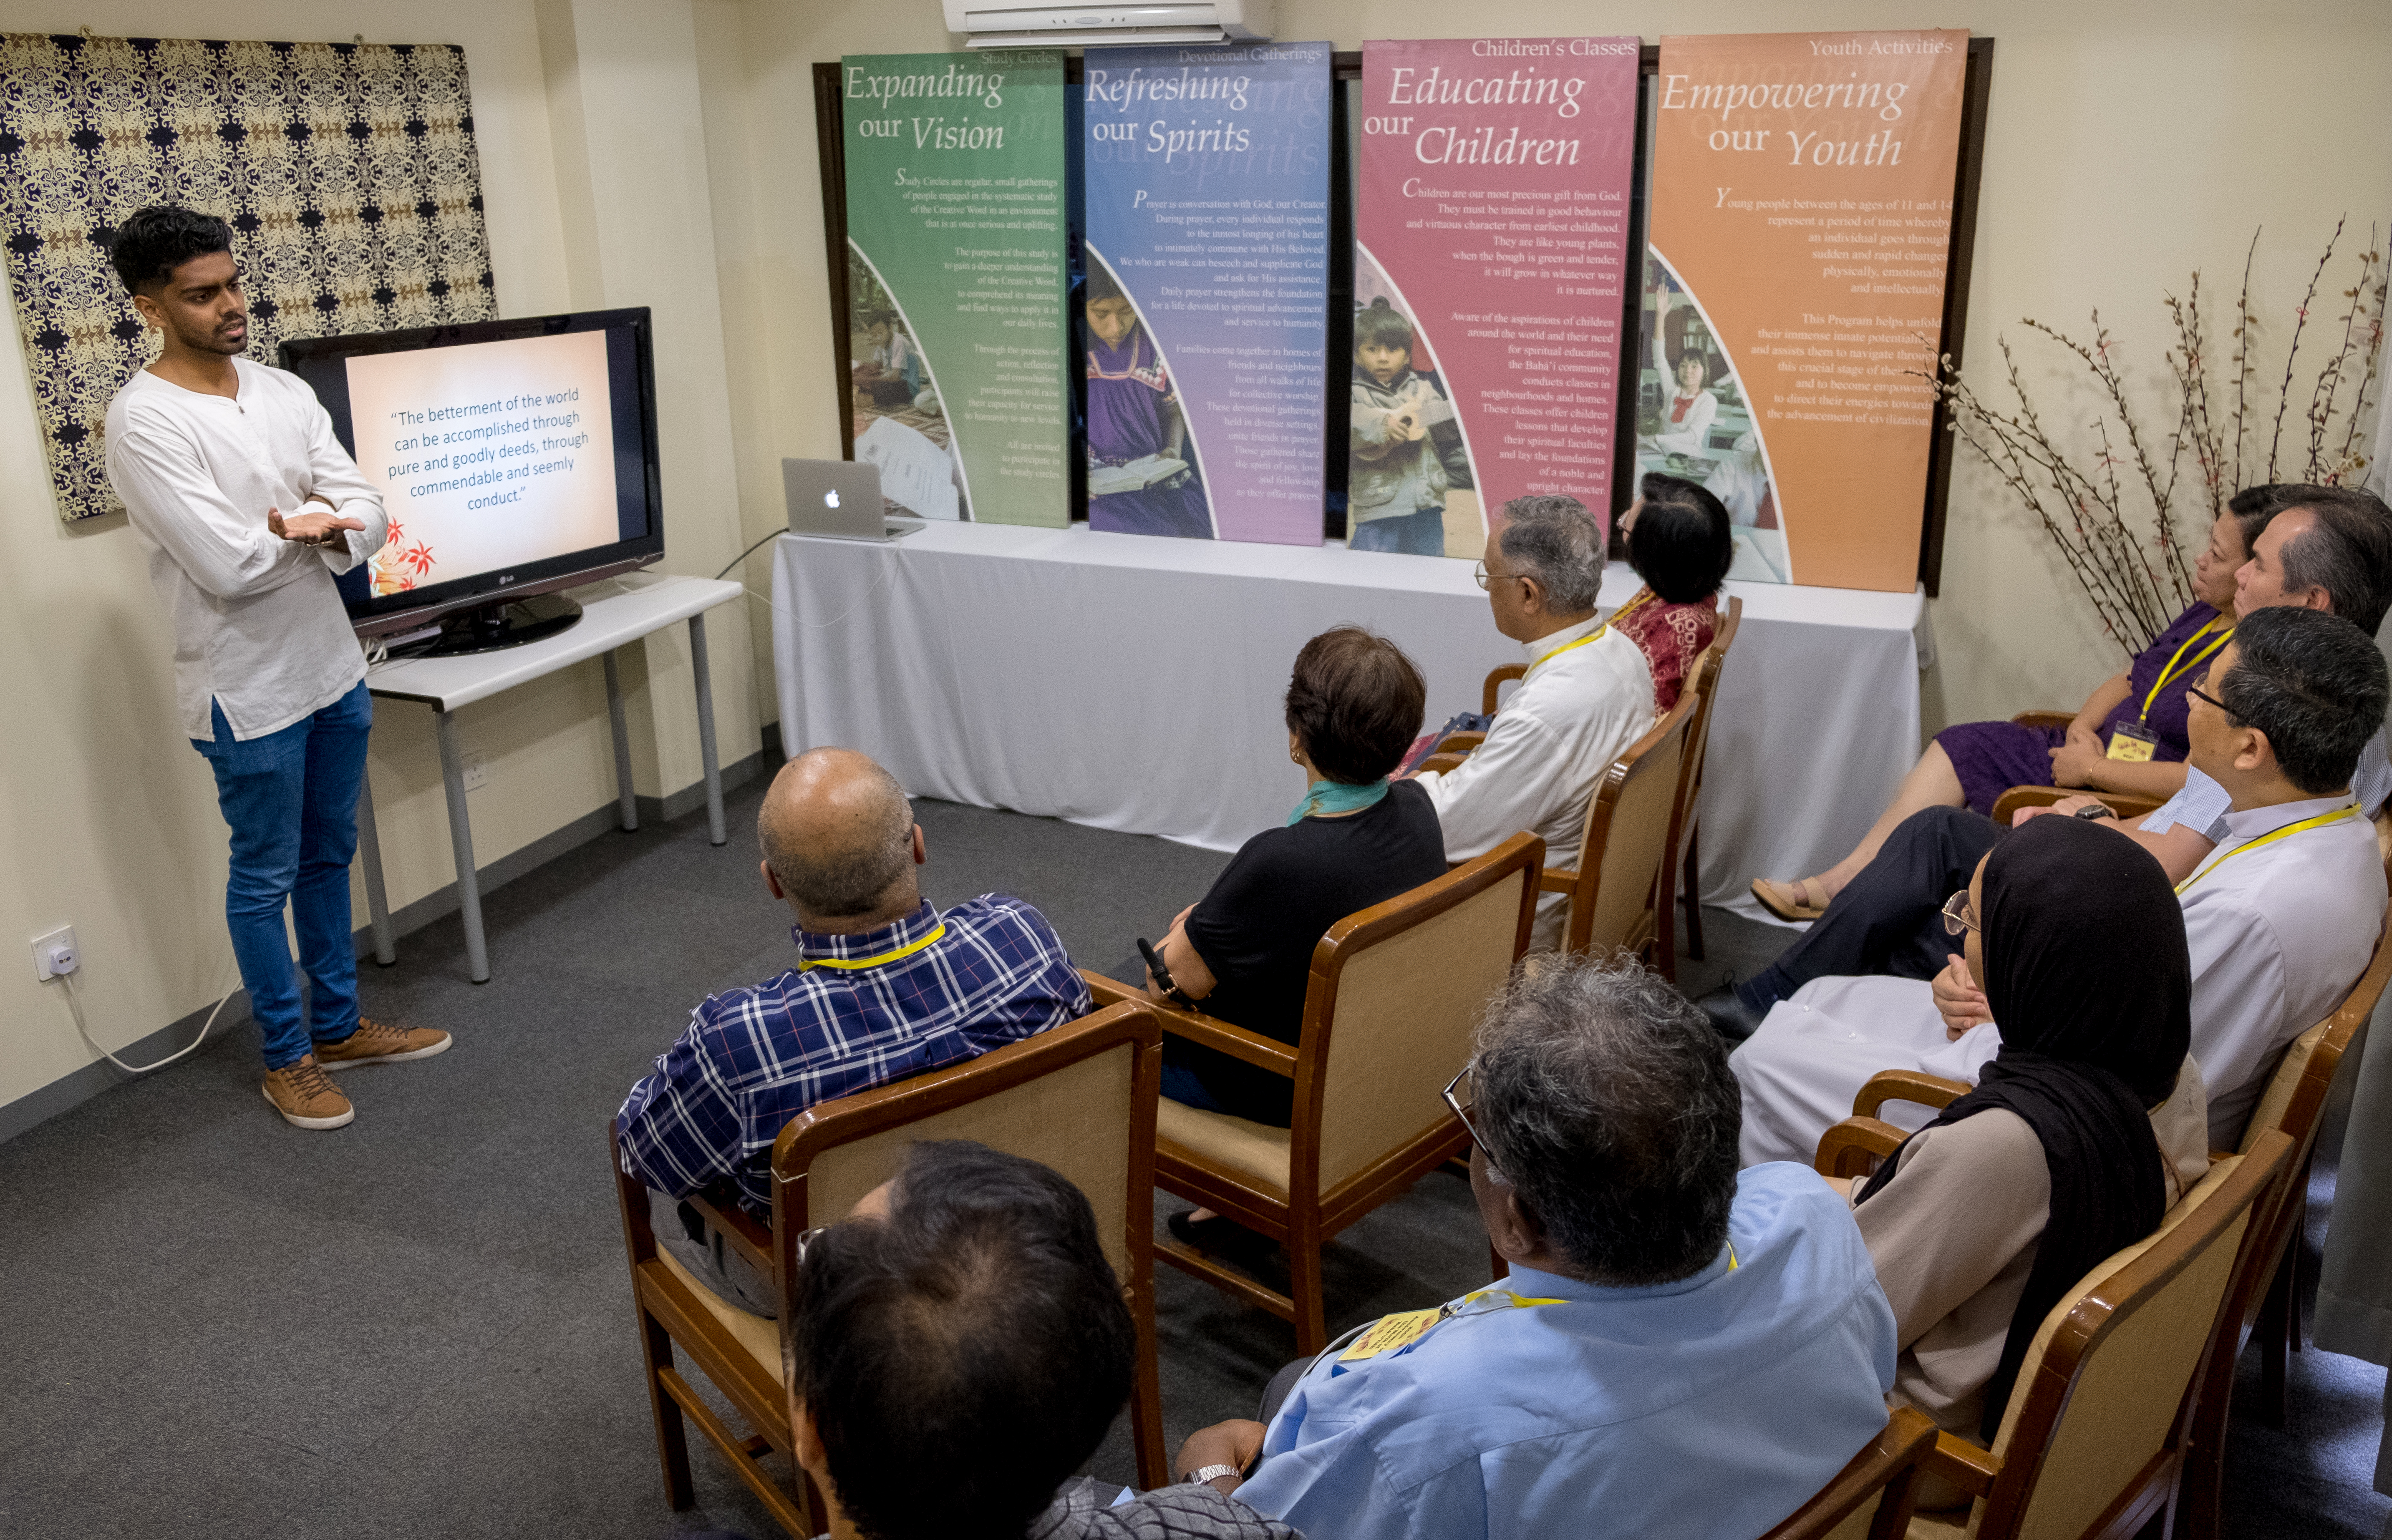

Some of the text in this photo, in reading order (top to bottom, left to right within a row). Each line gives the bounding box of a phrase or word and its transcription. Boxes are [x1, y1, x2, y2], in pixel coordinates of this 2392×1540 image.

[1179, 47, 1321, 63] Devotional Gatherings
[1570, 39, 1636, 56] Classes
[1810, 39, 1953, 55] Youth Activities
[982, 50, 1056, 68] Study Circles
[846, 64, 1005, 108] Expanding
[1086, 67, 1251, 112] Refreshing
[1388, 66, 1585, 118] Educating
[1662, 72, 1909, 121] Empowering
[859, 117, 1005, 149] our Vision
[1093, 119, 1250, 163] our Spirits
[1364, 116, 1580, 165] our Children
[1709, 129, 1902, 166] our Youth
[1178, 200, 1230, 208] conversation
[1233, 199, 1251, 208] with
[1512, 190, 1551, 202] precious
[1554, 190, 1570, 202] gift
[1573, 191, 1596, 200] from
[1438, 204, 1460, 215] They
[1487, 205, 1498, 214] be
[1501, 205, 1533, 215] trained
[1536, 206, 1545, 215] in
[1548, 206, 1571, 218] good
[1574, 207, 1622, 216] behaviour
[1756, 199, 1790, 211] people
[1793, 199, 1837, 209] between
[1840, 199, 1856, 209] the
[1859, 203, 1883, 212] ages
[1885, 200, 1897, 209] of
[1902, 200, 1912, 210] 11
[1916, 200, 1936, 210] and
[1156, 214, 1184, 225] During
[1242, 214, 1283, 224] individual
[1286, 215, 1323, 226] responds
[1406, 219, 1423, 228] and
[1425, 220, 1462, 229] virtuous
[1464, 220, 1505, 230] character
[1509, 221, 1531, 230] from
[1533, 222, 1567, 231] earliest
[1768, 216, 1815, 228] represent
[1827, 216, 1860, 229] period
[1863, 216, 1875, 226] of
[1878, 217, 1901, 226] time
[1905, 216, 1949, 229] whereby
[1493, 236, 1515, 248] They
[1536, 237, 1553, 247] like
[1556, 241, 1585, 250] young
[1824, 232, 1877, 243] individual
[1880, 237, 1904, 246] goes
[1908, 234, 1949, 247] through
[1453, 250, 1477, 260] when
[1479, 251, 1493, 260] the
[1496, 252, 1525, 264] bough
[1527, 253, 1535, 262] is
[1538, 256, 1564, 265] green
[1566, 254, 1584, 263] and
[1485, 267, 1617, 282] it will grow in whatever way
[1556, 285, 1563, 294] it
[1565, 286, 1574, 294] is
[1803, 314, 1941, 329] This Program helps unfold
[1508, 345, 1521, 354] for
[1524, 345, 1561, 358] spiritual
[1509, 360, 1522, 369] the
[1558, 362, 1610, 376] community
[428, 400, 502, 421] betterment
[506, 396, 519, 410] of
[522, 394, 542, 408] the
[546, 388, 579, 404] world
[1482, 403, 1607, 420] These classes offer children
[395, 410, 580, 451] can be accomplished through
[388, 432, 588, 480] pure and goodly deeds, through
[411, 456, 574, 497] commendable and seemly
